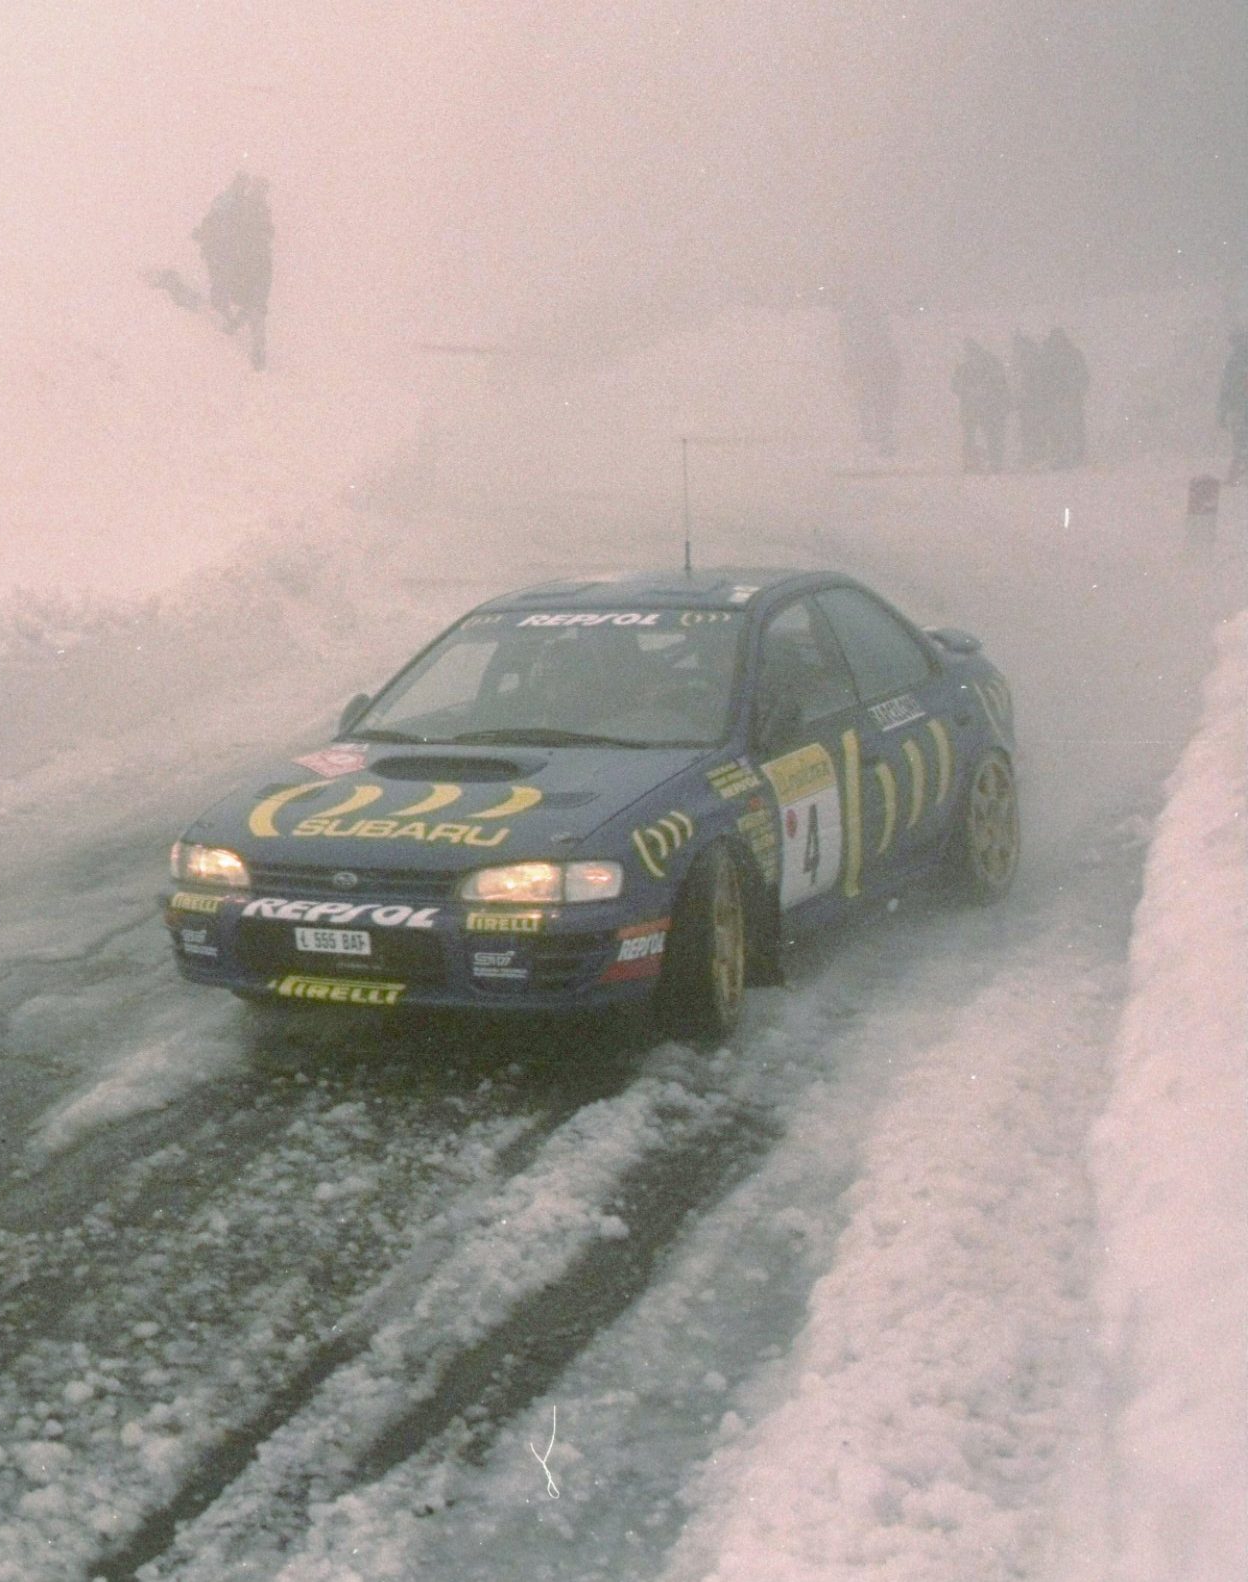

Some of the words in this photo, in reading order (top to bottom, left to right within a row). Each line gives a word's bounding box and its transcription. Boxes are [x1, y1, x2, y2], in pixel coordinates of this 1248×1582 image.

[517, 612, 661, 627] REPSOL
[292, 818, 510, 847] SUBARU
[803, 803, 820, 884] 4
[241, 898, 440, 928] REPSOL
[466, 911, 542, 933] PIRELLI
[314, 932, 336, 949] 555
[269, 974, 406, 1005] PIRELLI
